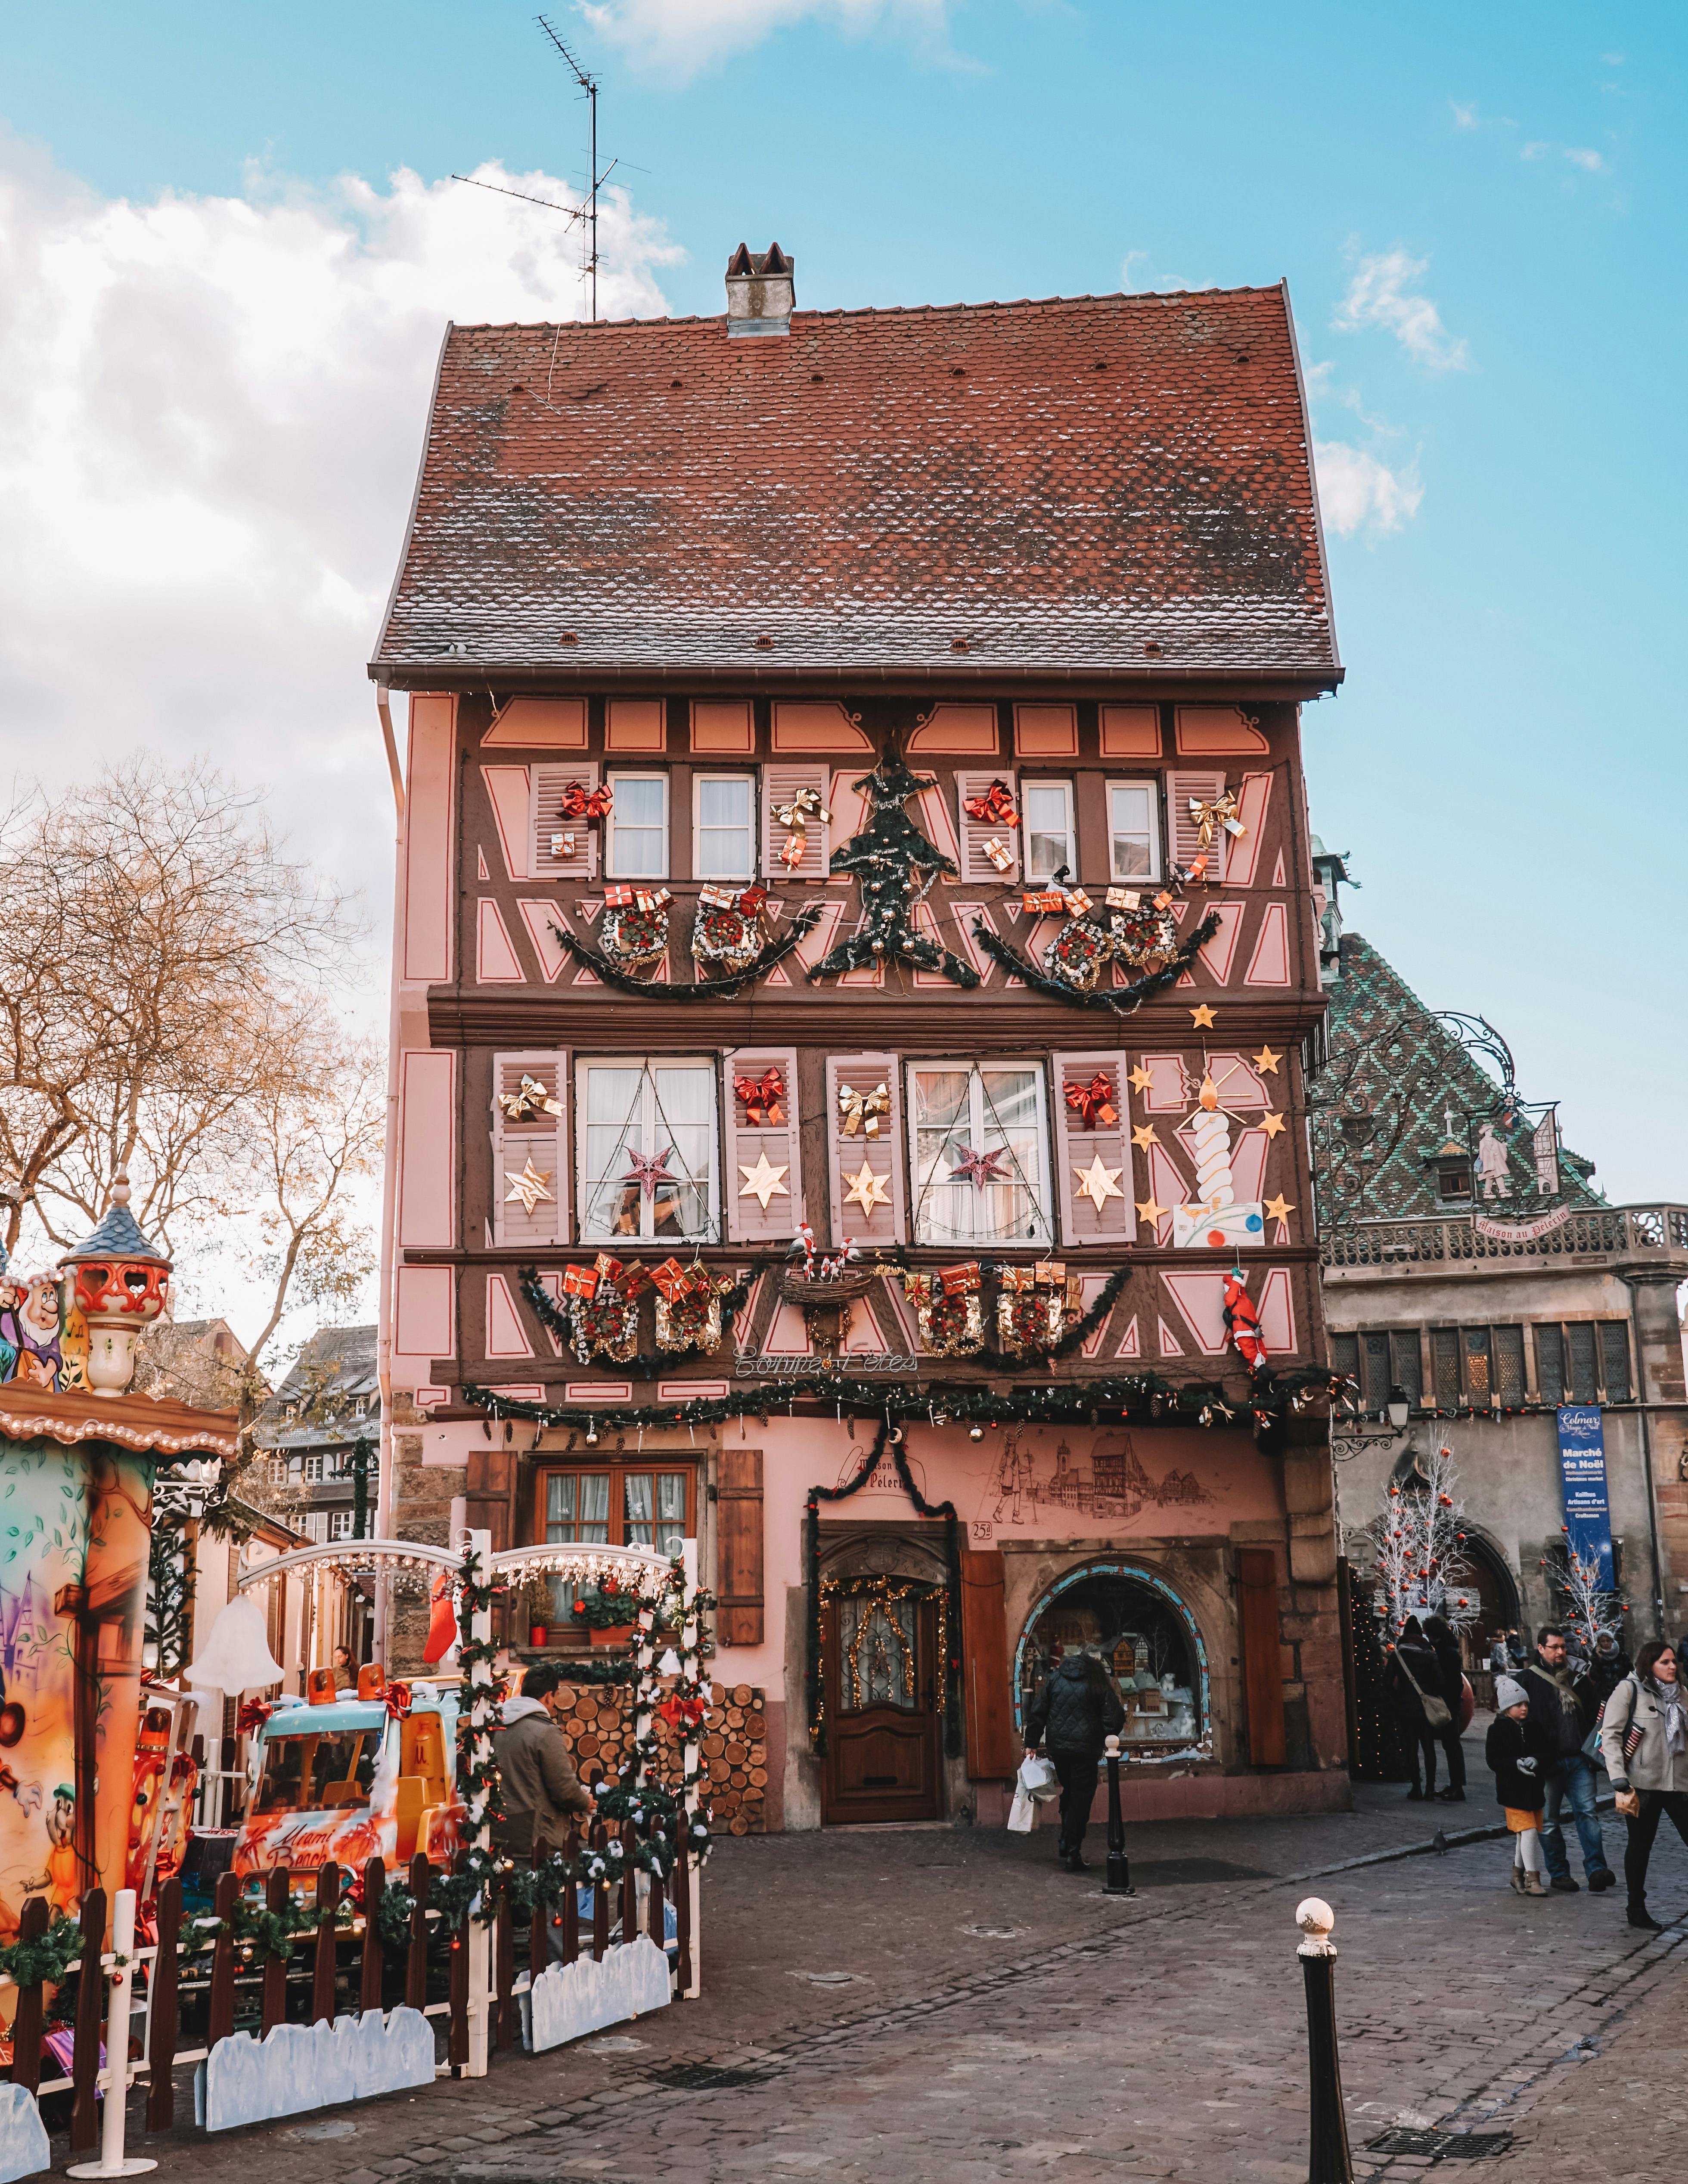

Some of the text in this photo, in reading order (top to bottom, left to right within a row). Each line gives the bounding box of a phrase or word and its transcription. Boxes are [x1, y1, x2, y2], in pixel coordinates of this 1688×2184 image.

[1477, 1221, 1512, 1238] Maison
[1560, 1412, 1600, 1425] Colmar
[1563, 1448, 1602, 1457] Marché
[860, 1459, 892, 1470] Mson
[1564, 1459, 1604, 1469] de Noël
[267, 1844, 327, 1867] Beach
